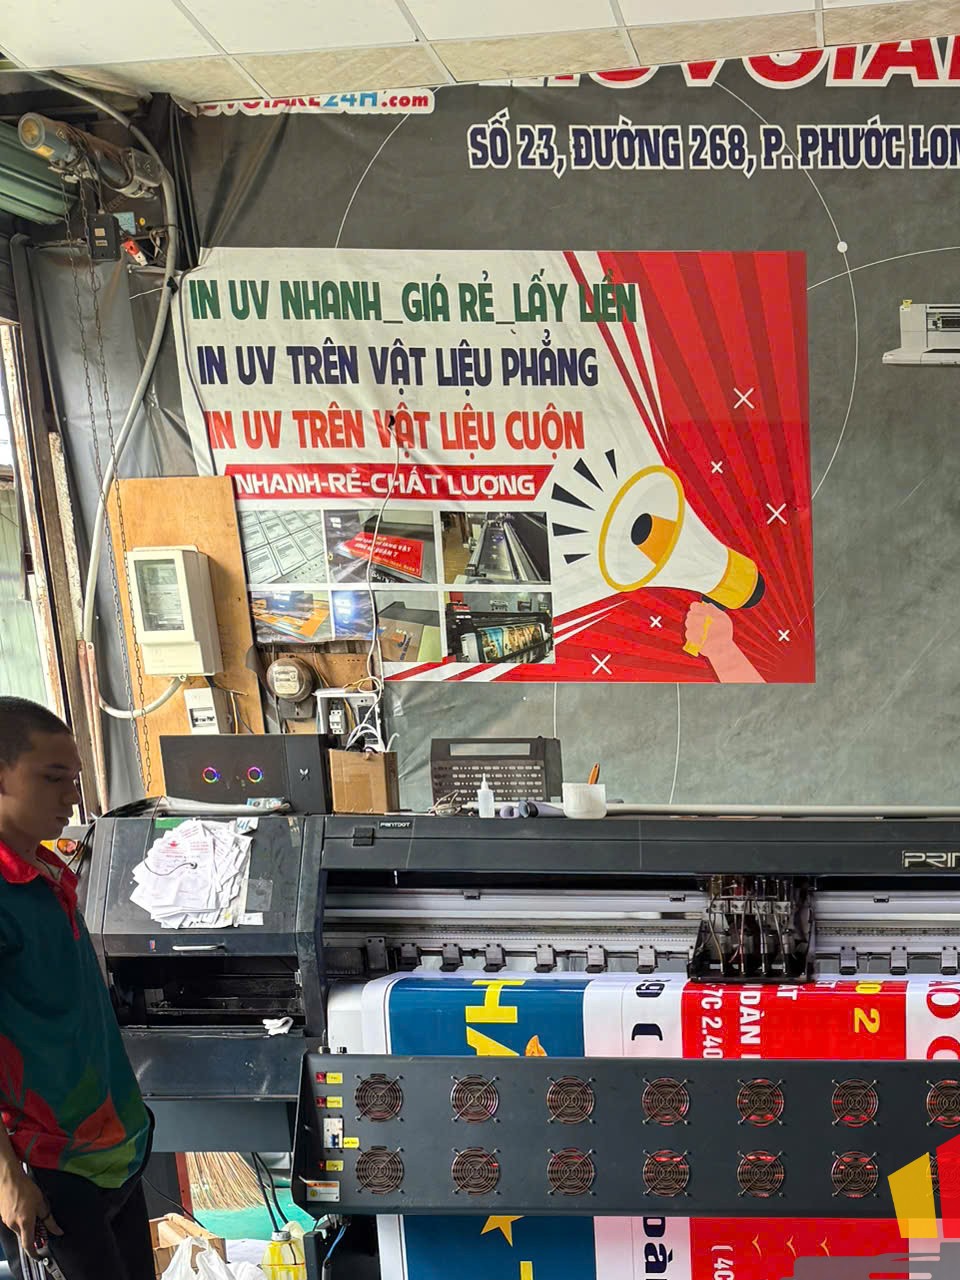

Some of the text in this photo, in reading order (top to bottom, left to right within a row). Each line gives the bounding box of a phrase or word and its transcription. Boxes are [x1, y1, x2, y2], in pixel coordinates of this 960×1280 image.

[467, 107, 509, 170] SỐ
[517, 123, 567, 178] 23,
[569, 115, 684, 170] ĐƯỜNG
[687, 123, 757, 179] 268,
[760, 124, 794, 170] P.
[796, 115, 905, 170] PHƯỚC
[189, 280, 221, 320] IN
[228, 280, 270, 320] UV
[197, 346, 228, 385] IN
[236, 346, 276, 386] UV
[286, 337, 360, 385] TRÊN
[368, 338, 427, 395] VẬT
[436, 339, 492, 397] LIỆU
[204, 401, 586, 460] IN UV TRÊN VẬT LIỆU CUỘN
[448, 473, 536, 501] LƯỢNG
[701, 1015, 724, 1059] 2.40
[739, 990, 766, 1044] DÀN
[854, 1007, 881, 1034] 2
